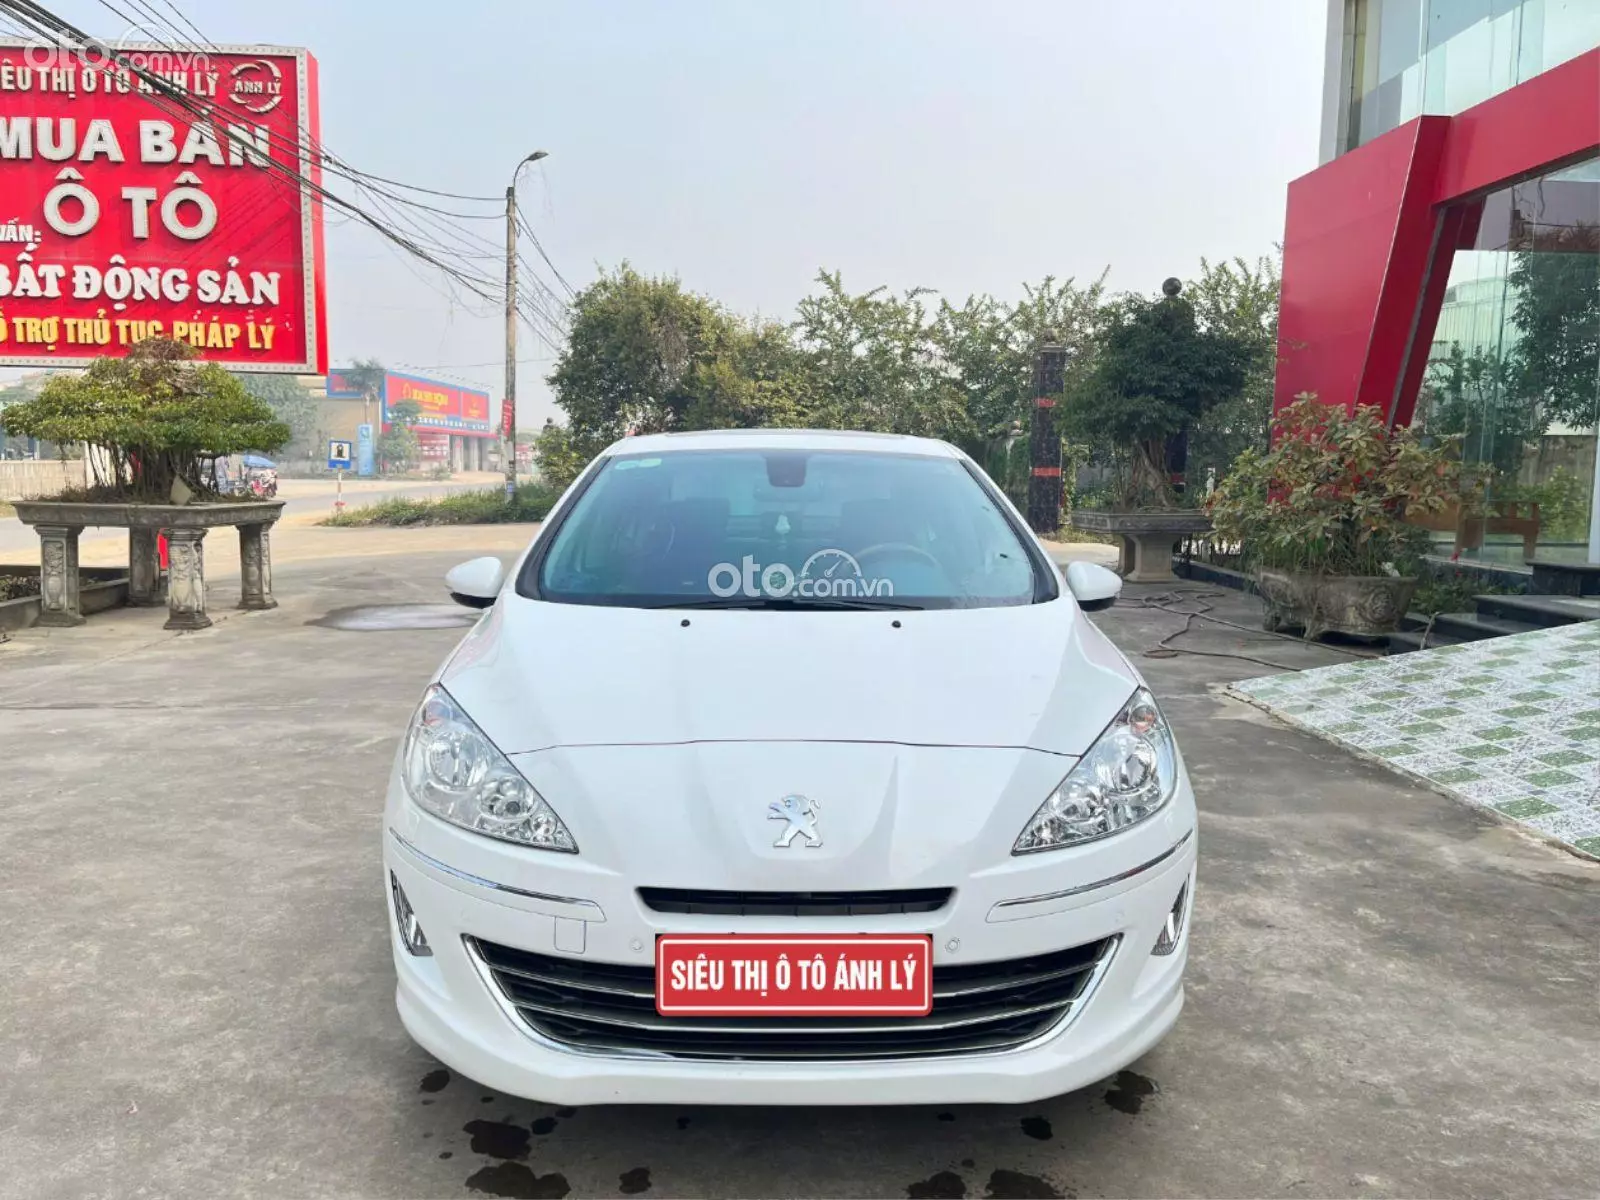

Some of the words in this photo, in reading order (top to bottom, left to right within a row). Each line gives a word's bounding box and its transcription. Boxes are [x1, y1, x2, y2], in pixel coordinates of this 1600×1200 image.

[36, 66, 76, 98] THỊ
[194, 64, 219, 97] LÝ
[0, 116, 125, 162] MUA
[139, 105, 272, 168] BÁN
[43, 167, 100, 237] Ô
[121, 171, 218, 240] TÔ
[72, 254, 190, 310] ĐỘNG
[197, 256, 280, 305] SẢN
[12, 316, 60, 351] TRỢ
[63, 309, 111, 345] THỦ
[173, 316, 241, 348] PHÁP
[671, 954, 725, 990] SIÊU
[731, 959, 768, 997] THỊ
[775, 954, 791, 990] Ô
[797, 954, 827, 990] TÔ
[833, 953, 883, 990] ÁNH
[889, 953, 917, 990] LÝ
